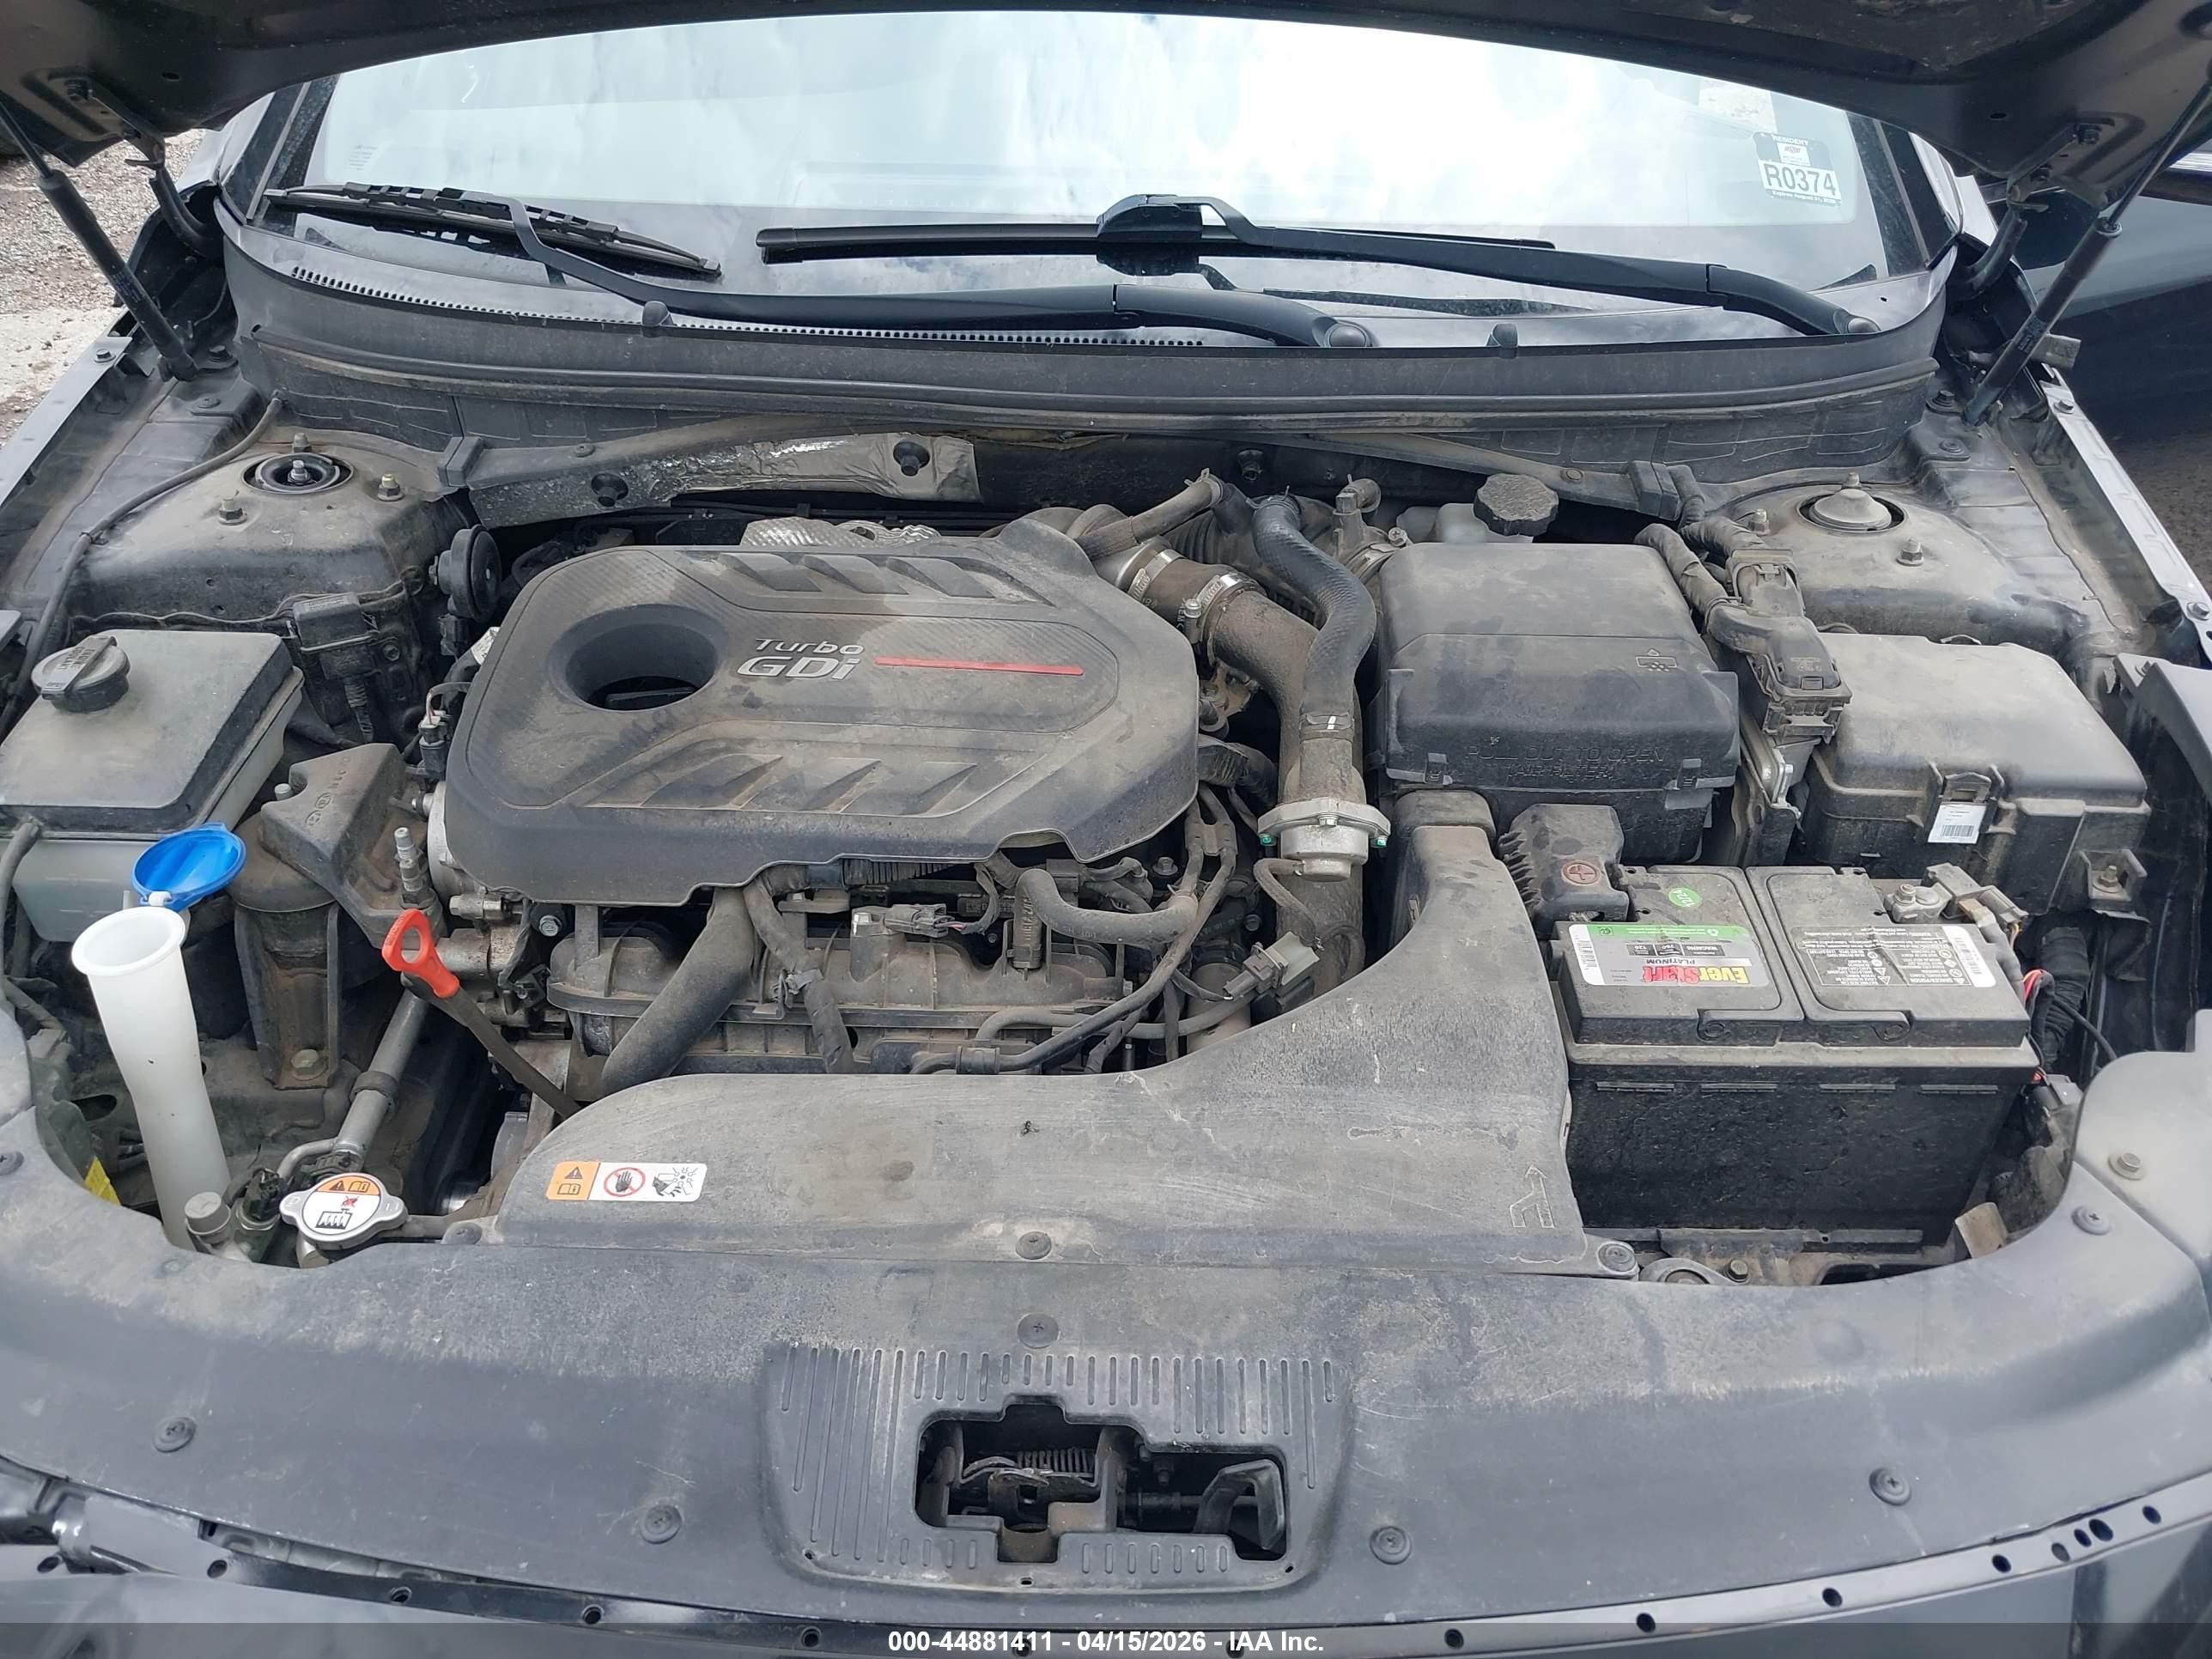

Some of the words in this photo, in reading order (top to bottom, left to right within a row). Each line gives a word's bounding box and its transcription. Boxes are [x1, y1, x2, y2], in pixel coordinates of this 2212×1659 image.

[1764, 163, 1836, 196] R0374
[756, 638, 865, 654] Turbo
[737, 656, 860, 680] GDi
[1524, 745, 1568, 761] OUT
[1575, 747, 1601, 762] TO
[1607, 748, 1665, 763] OPEN
[1642, 964, 1750, 985] EverStart
